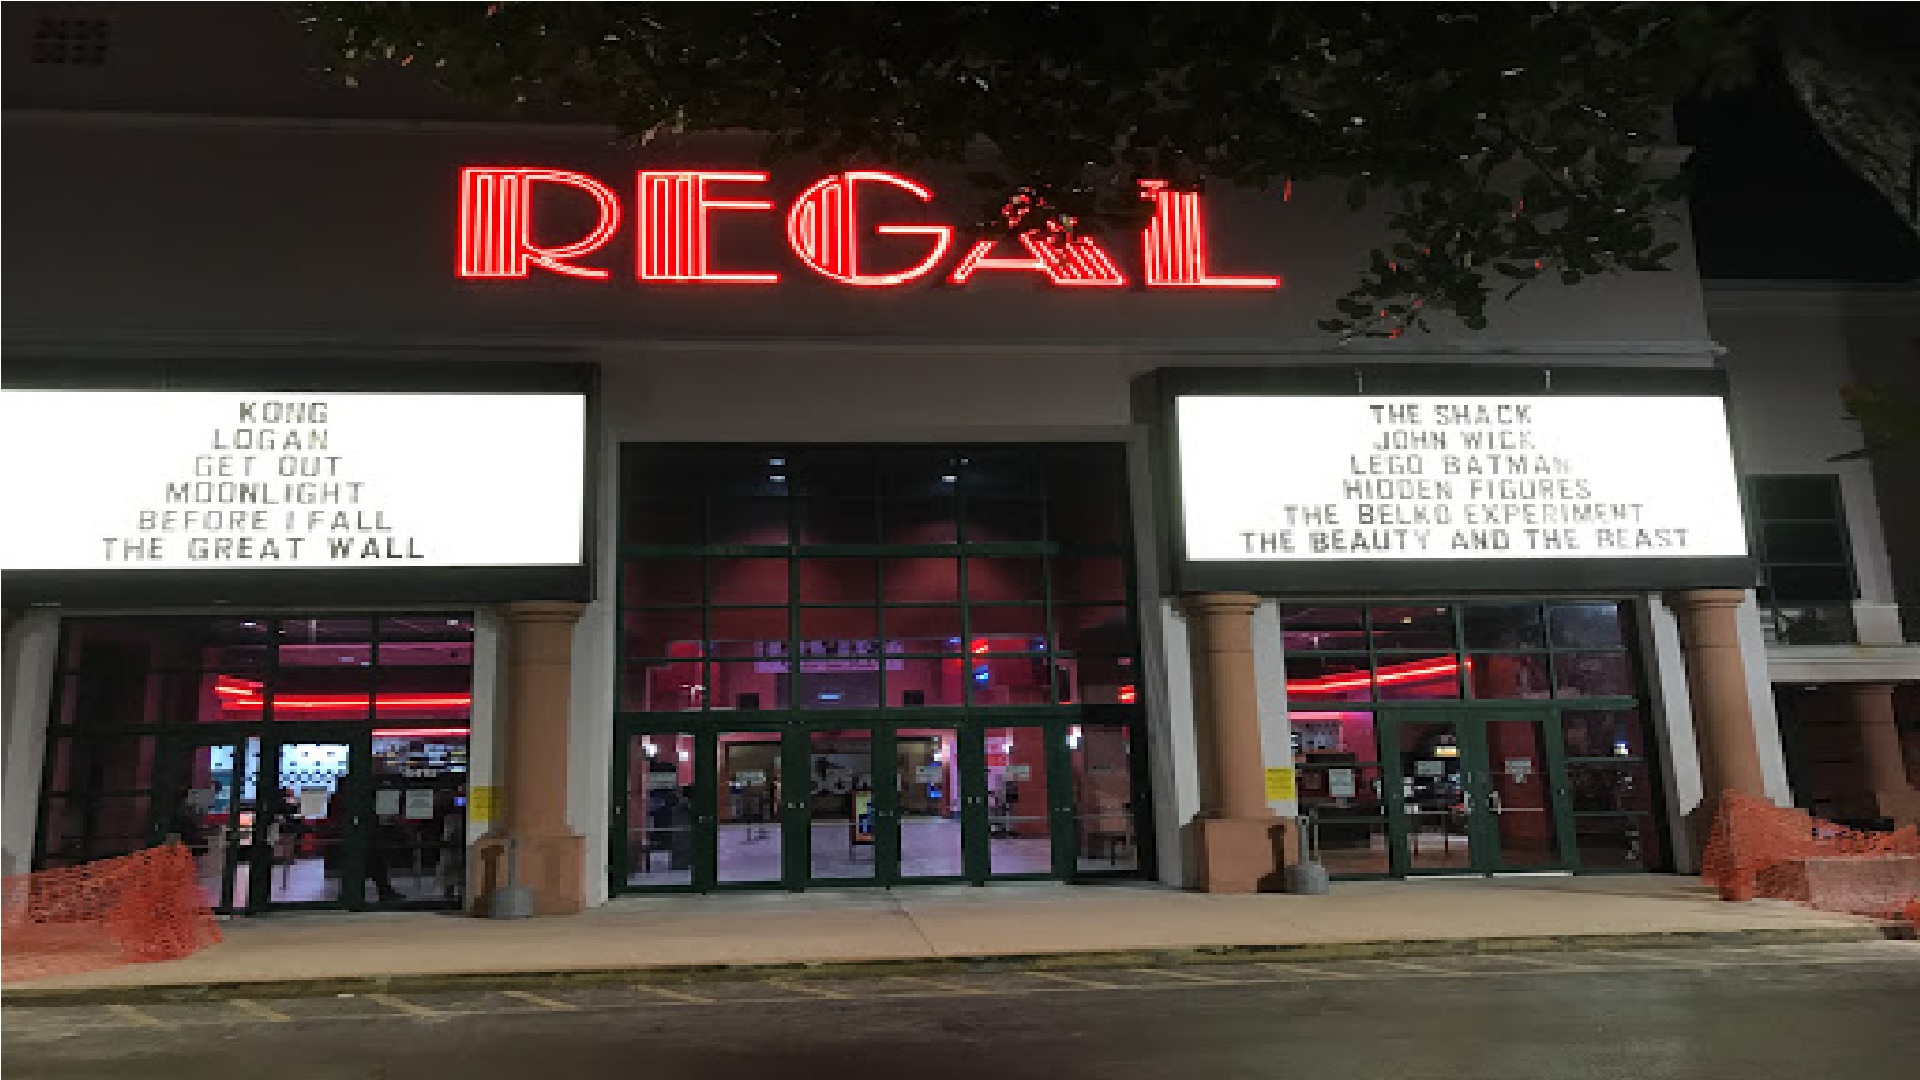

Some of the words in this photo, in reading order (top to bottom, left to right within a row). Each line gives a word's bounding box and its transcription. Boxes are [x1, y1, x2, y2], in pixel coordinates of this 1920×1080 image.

[457, 167, 1280, 288] REGAL
[240, 400, 327, 423] KONG
[1370, 403, 1422, 425] THE
[1433, 404, 1533, 426] SHACK
[211, 429, 327, 451] LOGAN
[1373, 429, 1445, 451] JOHN
[1459, 430, 1536, 451] WICK
[195, 455, 257, 477] GET
[279, 454, 342, 476] OUT
[1350, 454, 1423, 475] LEGO
[1441, 454, 1572, 475] BATMAN
[166, 482, 365, 504] MOONLIGHT
[1343, 479, 1452, 499] HIDDEN
[1471, 479, 1591, 499] FIGURES
[139, 510, 268, 531] BEFORE
[285, 510, 295, 531] I
[307, 510, 391, 531] FALL
[1284, 504, 1339, 526] THE
[1359, 504, 1452, 524] BELKO
[1464, 504, 1643, 524] EXPERIMENT
[103, 538, 162, 561] THE
[188, 536, 305, 561] GREAT
[327, 536, 424, 558] WALL
[1241, 530, 1296, 554] THE
[1309, 529, 1430, 553] BEAUTY
[1452, 529, 1509, 549] AND
[1523, 529, 1580, 549] THE
